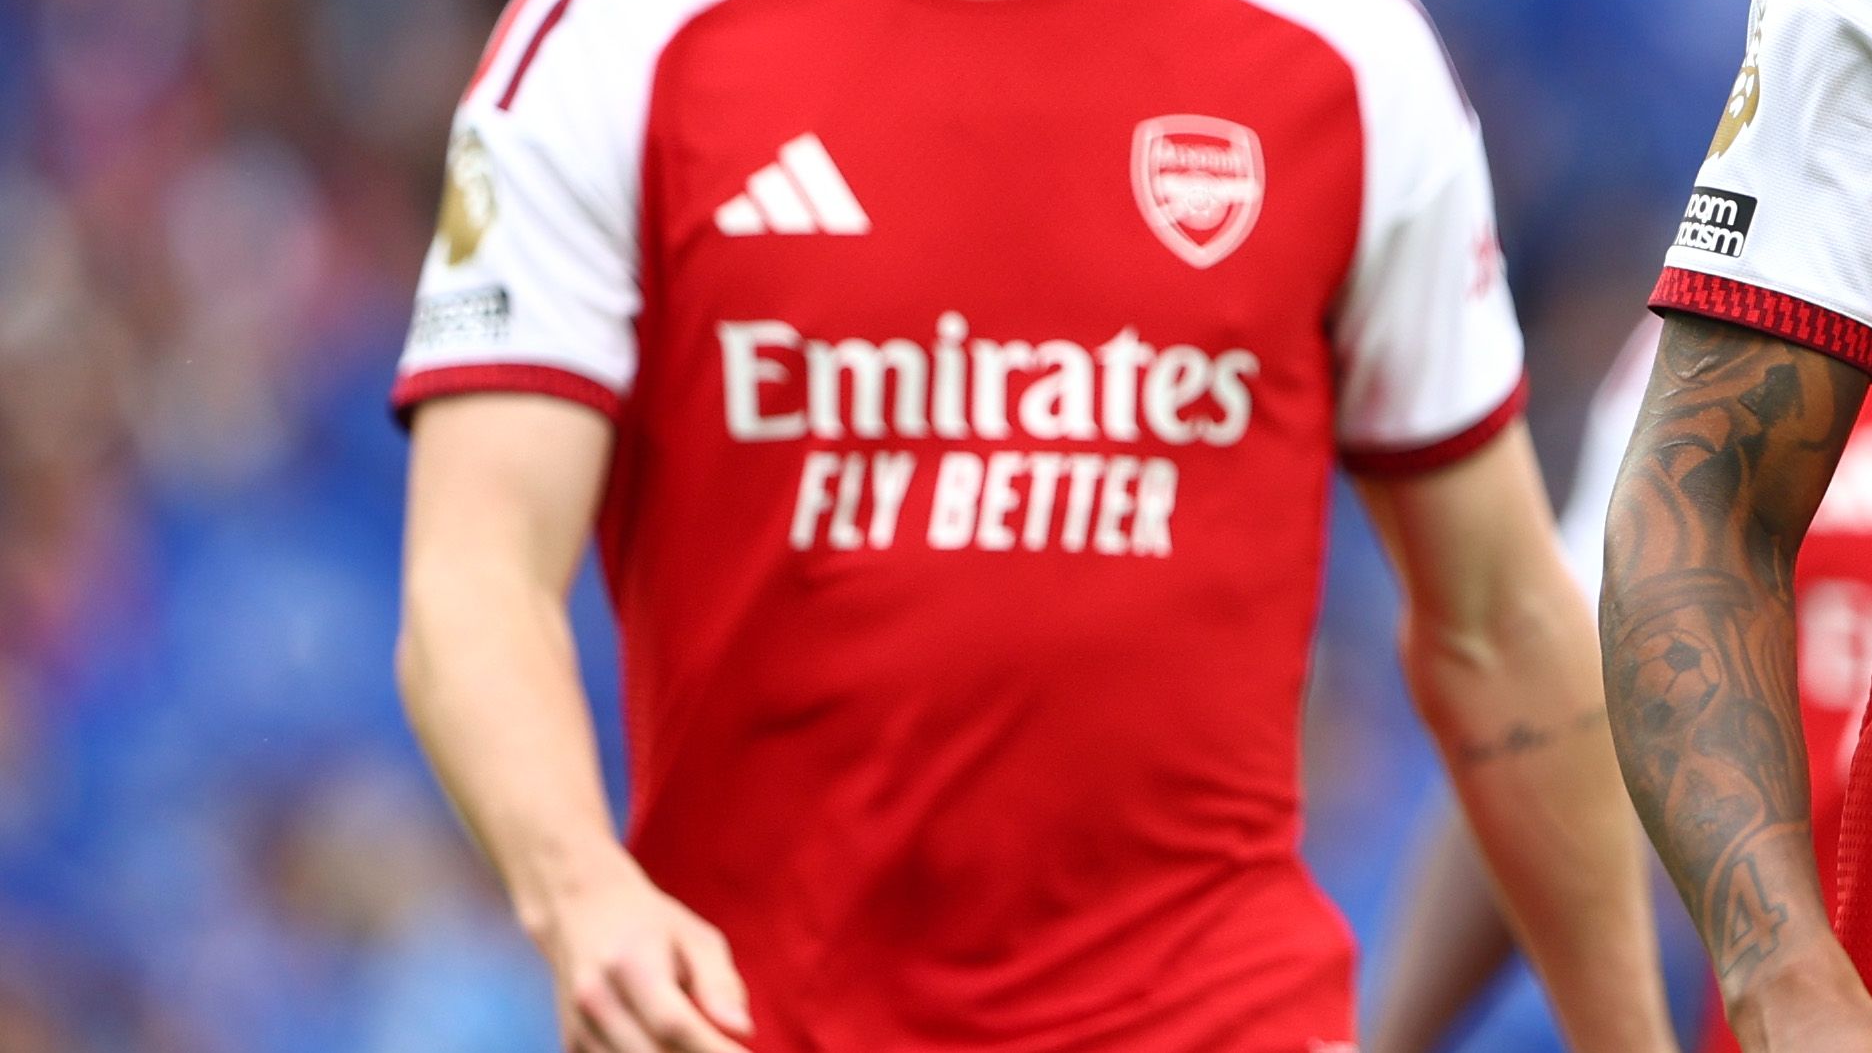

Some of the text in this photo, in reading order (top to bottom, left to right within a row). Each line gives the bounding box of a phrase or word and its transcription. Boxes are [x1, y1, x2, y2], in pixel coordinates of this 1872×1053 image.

[715, 310, 1261, 447] Emirates
[788, 450, 1180, 559] FLY BETTER
